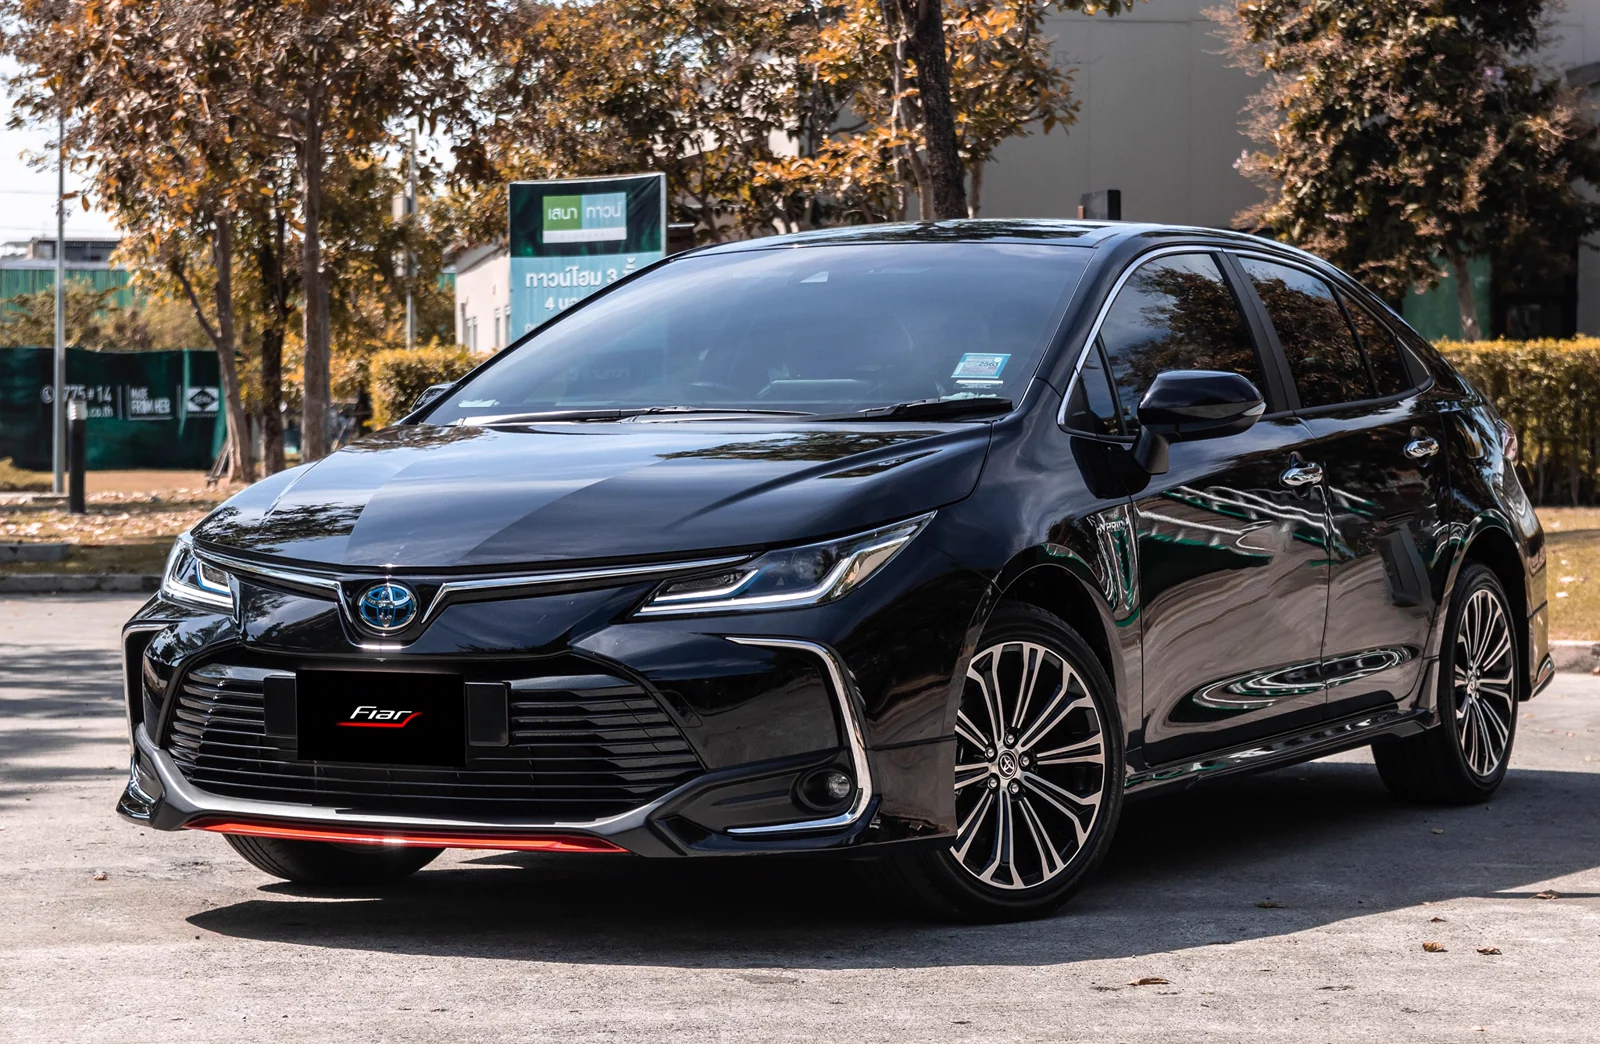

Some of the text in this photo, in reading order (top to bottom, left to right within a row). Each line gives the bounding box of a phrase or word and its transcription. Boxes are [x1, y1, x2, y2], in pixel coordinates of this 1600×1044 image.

[548, 202, 622, 220] เสนา ทาวน์
[526, 266, 602, 287] ทาวน์โฮม
[606, 267, 618, 284] 3
[544, 296, 555, 311] 4
[349, 705, 412, 720] Fiar
